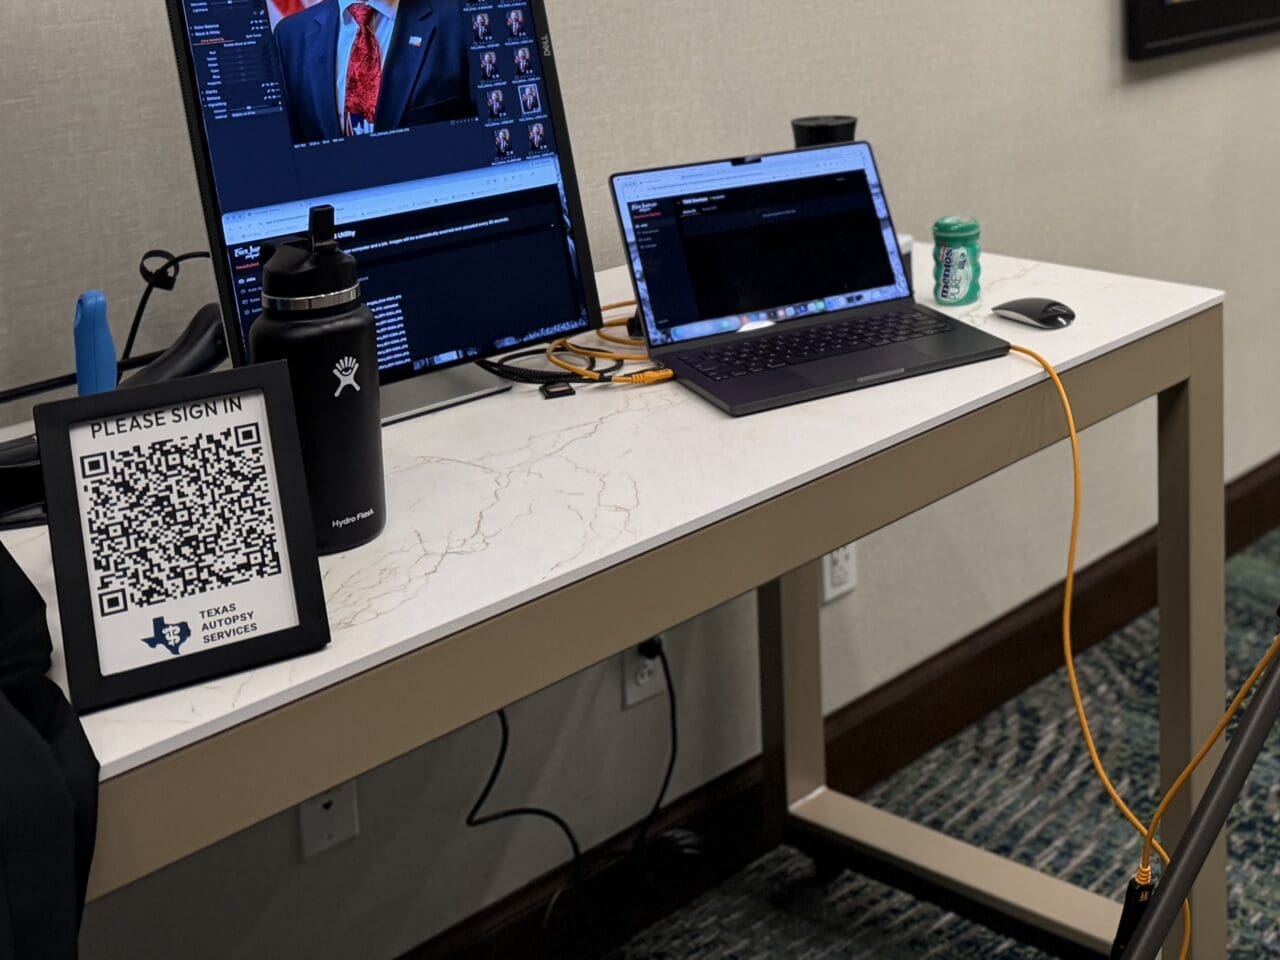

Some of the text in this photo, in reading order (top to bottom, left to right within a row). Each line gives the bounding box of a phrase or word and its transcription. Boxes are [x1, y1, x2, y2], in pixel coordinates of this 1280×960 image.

[941, 247, 953, 298] mentos
[90, 395, 242, 439] PLEASE SIGN IN
[331, 516, 356, 528] Hydro
[199, 603, 236, 620] TEXAS
[201, 610, 254, 632] AUTOPSY
[203, 622, 257, 644] SERVICES
